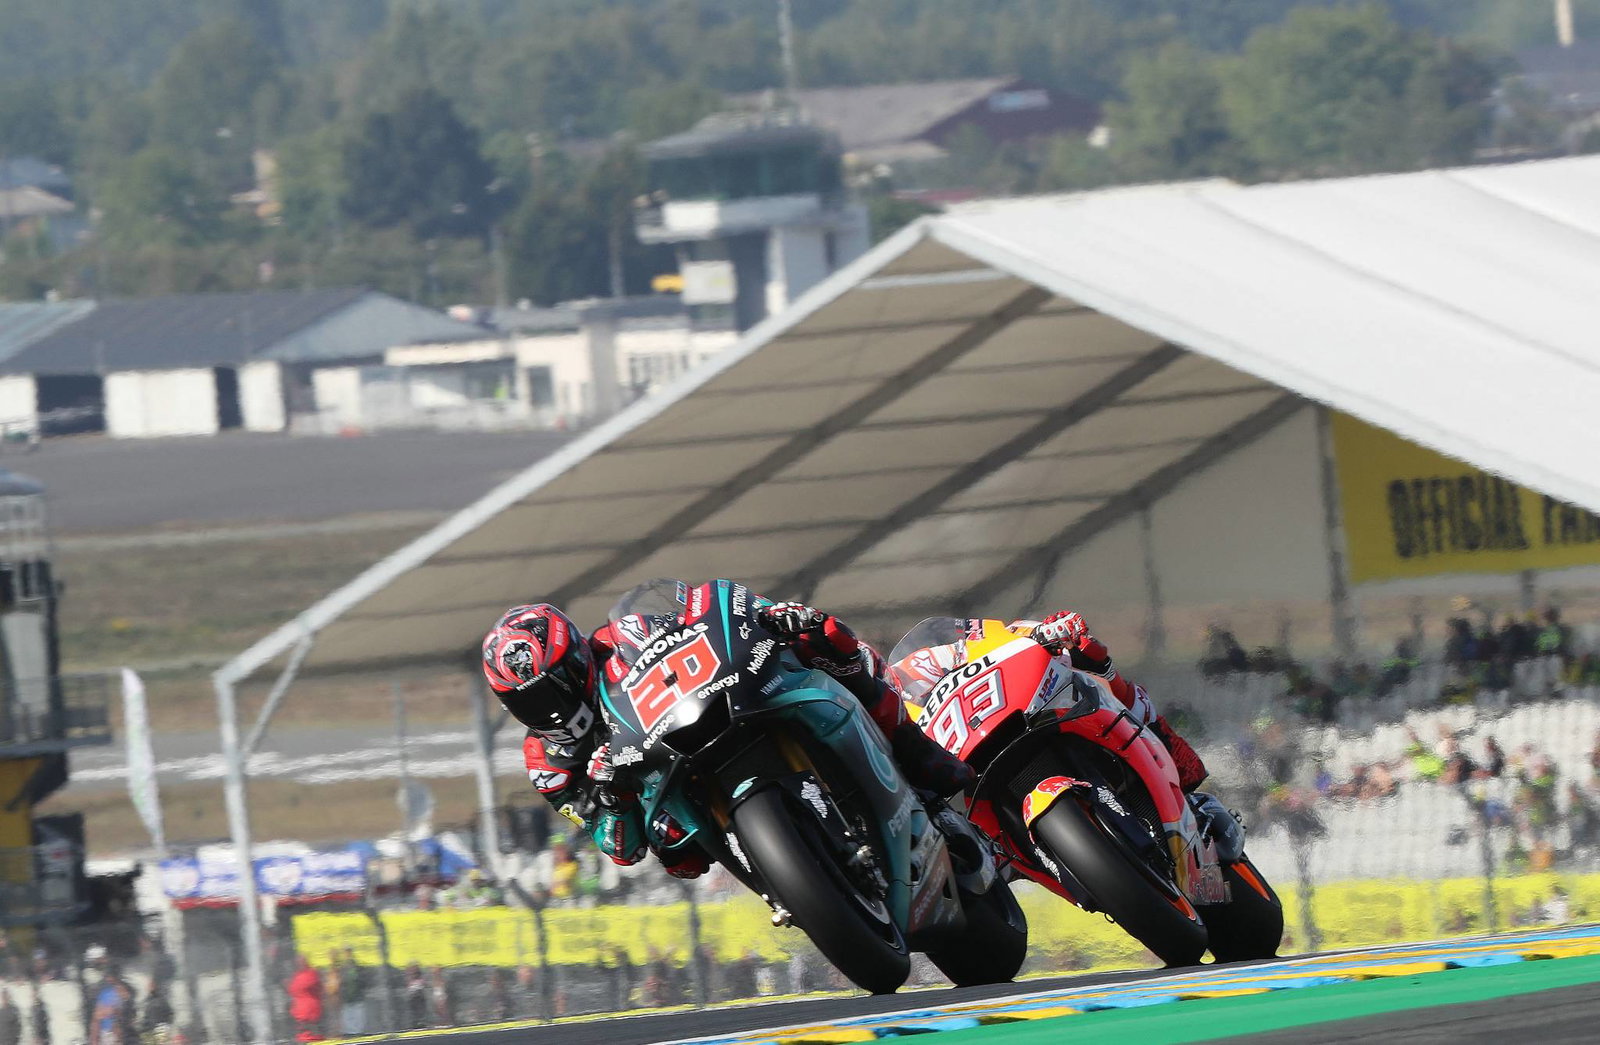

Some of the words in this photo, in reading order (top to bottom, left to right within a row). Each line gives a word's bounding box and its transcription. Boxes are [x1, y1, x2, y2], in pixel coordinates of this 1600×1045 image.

[620, 622, 710, 692] PETRONAS
[626, 632, 722, 734] 20
[697, 672, 741, 700] energy
[746, 638, 777, 675] Malaysia
[916, 655, 997, 727] REPSOL
[642, 714, 675, 750] europe
[932, 668, 1007, 756] 93
